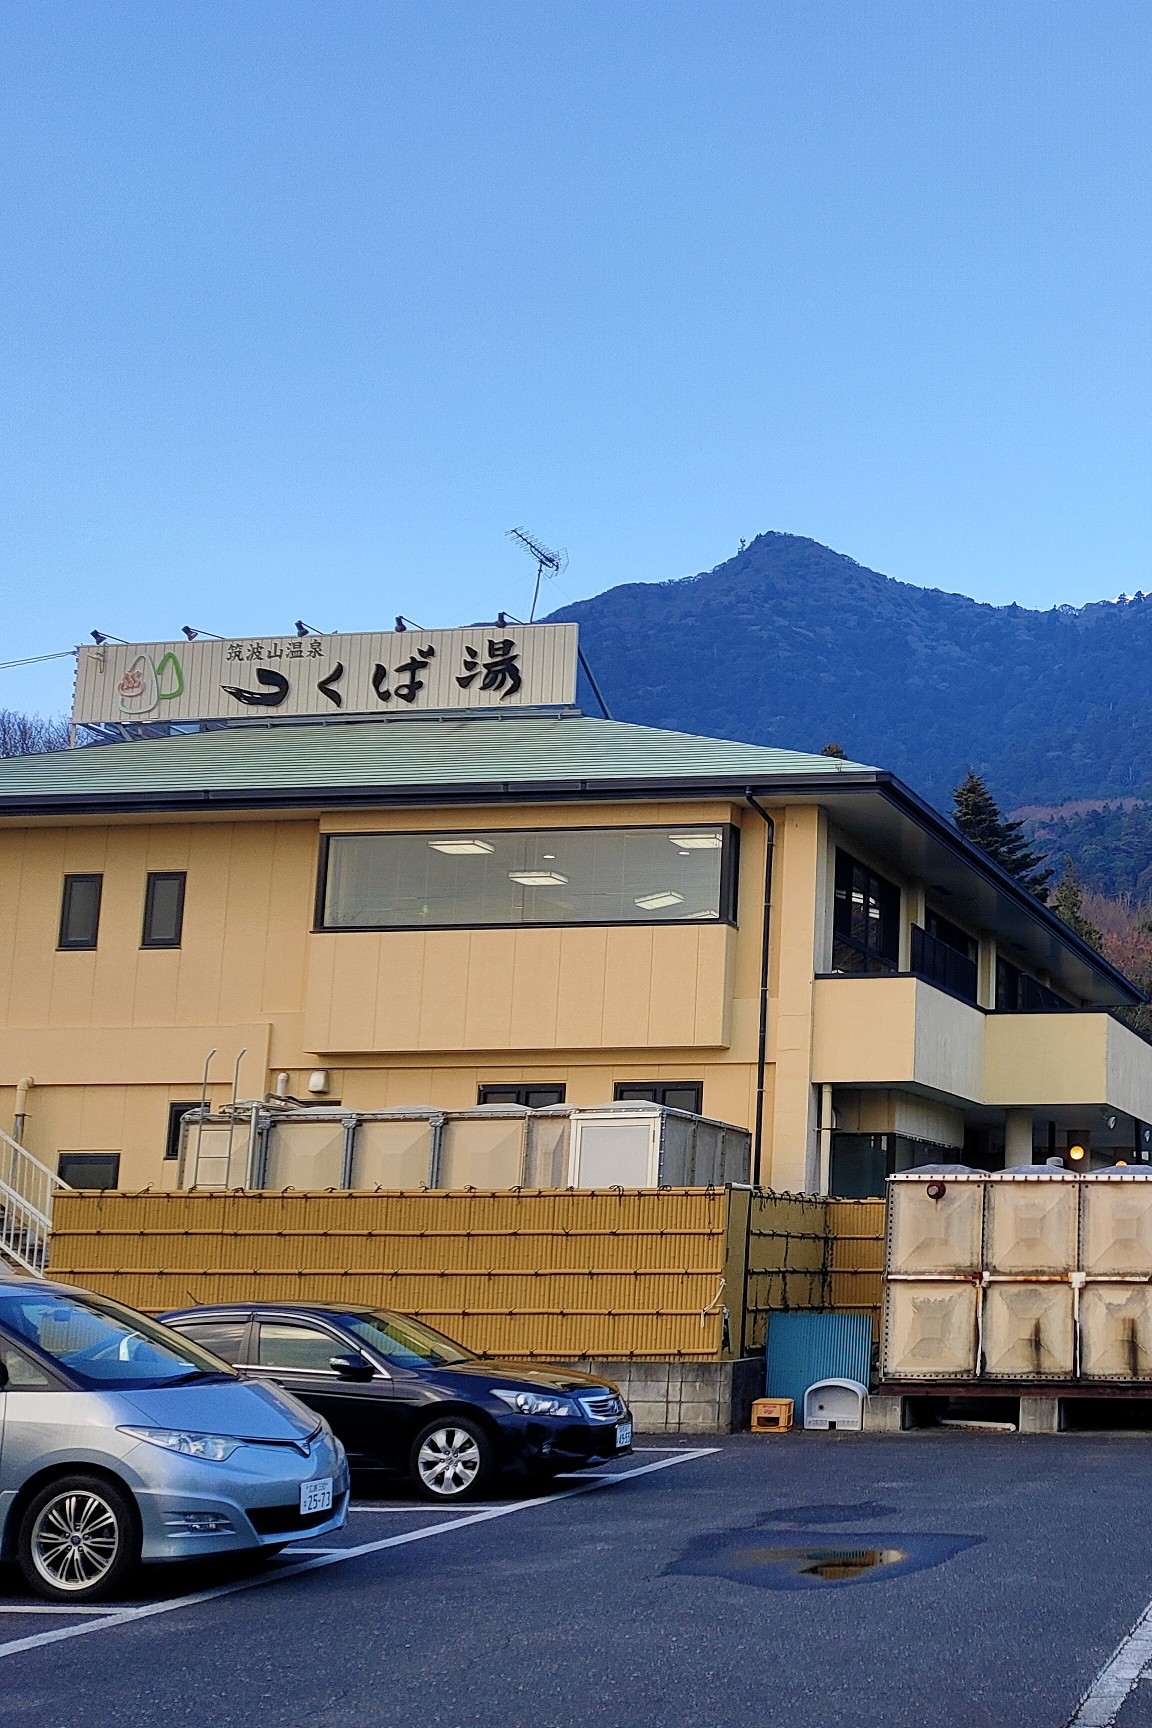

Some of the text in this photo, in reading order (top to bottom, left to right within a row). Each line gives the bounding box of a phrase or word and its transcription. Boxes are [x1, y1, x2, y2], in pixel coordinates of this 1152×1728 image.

[226, 639, 324, 661] 筑波山温泉
[219, 638, 522, 707] つくば湯
[307, 1491, 331, 1510] 25-73
